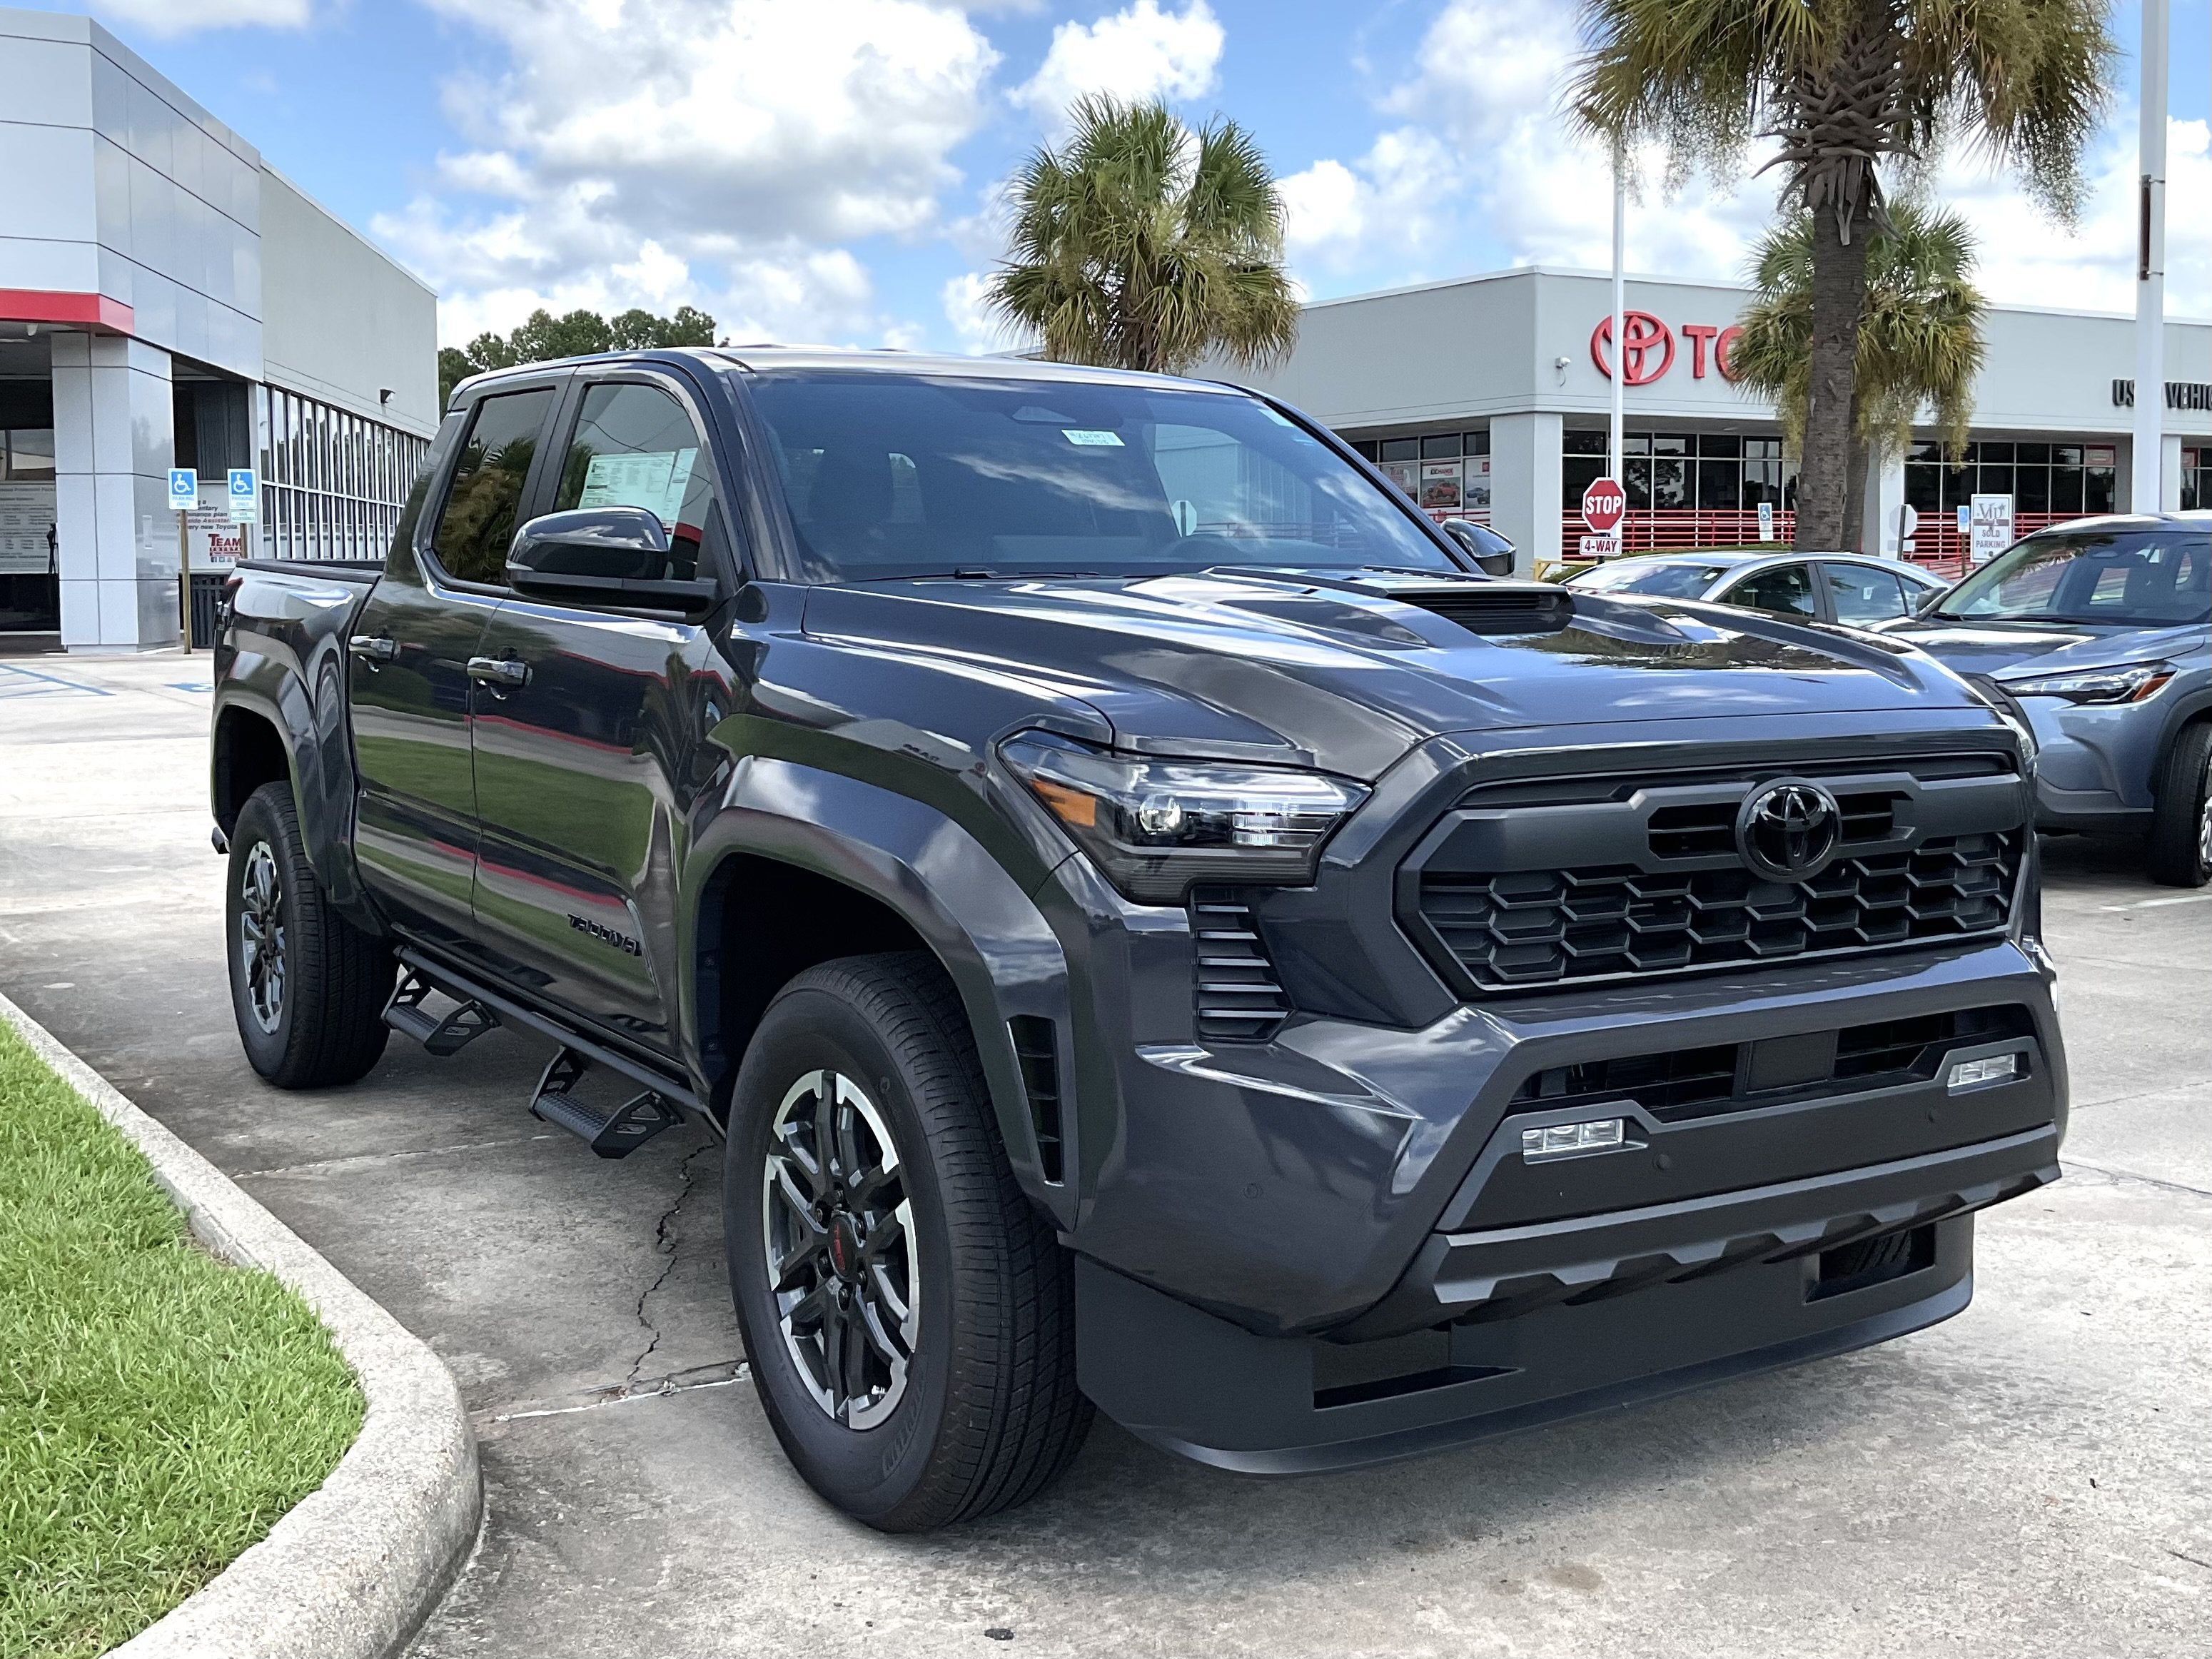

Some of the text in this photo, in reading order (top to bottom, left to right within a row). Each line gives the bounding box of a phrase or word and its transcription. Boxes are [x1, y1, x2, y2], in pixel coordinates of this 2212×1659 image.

[2112, 379, 2134, 407] US
[1585, 495, 1622, 514] STOP
[208, 534, 241, 547] TEAM
[1981, 529, 2000, 538] SOLD
[1585, 540, 1617, 553] 4-WAY
[567, 913, 642, 957] TACOMA
